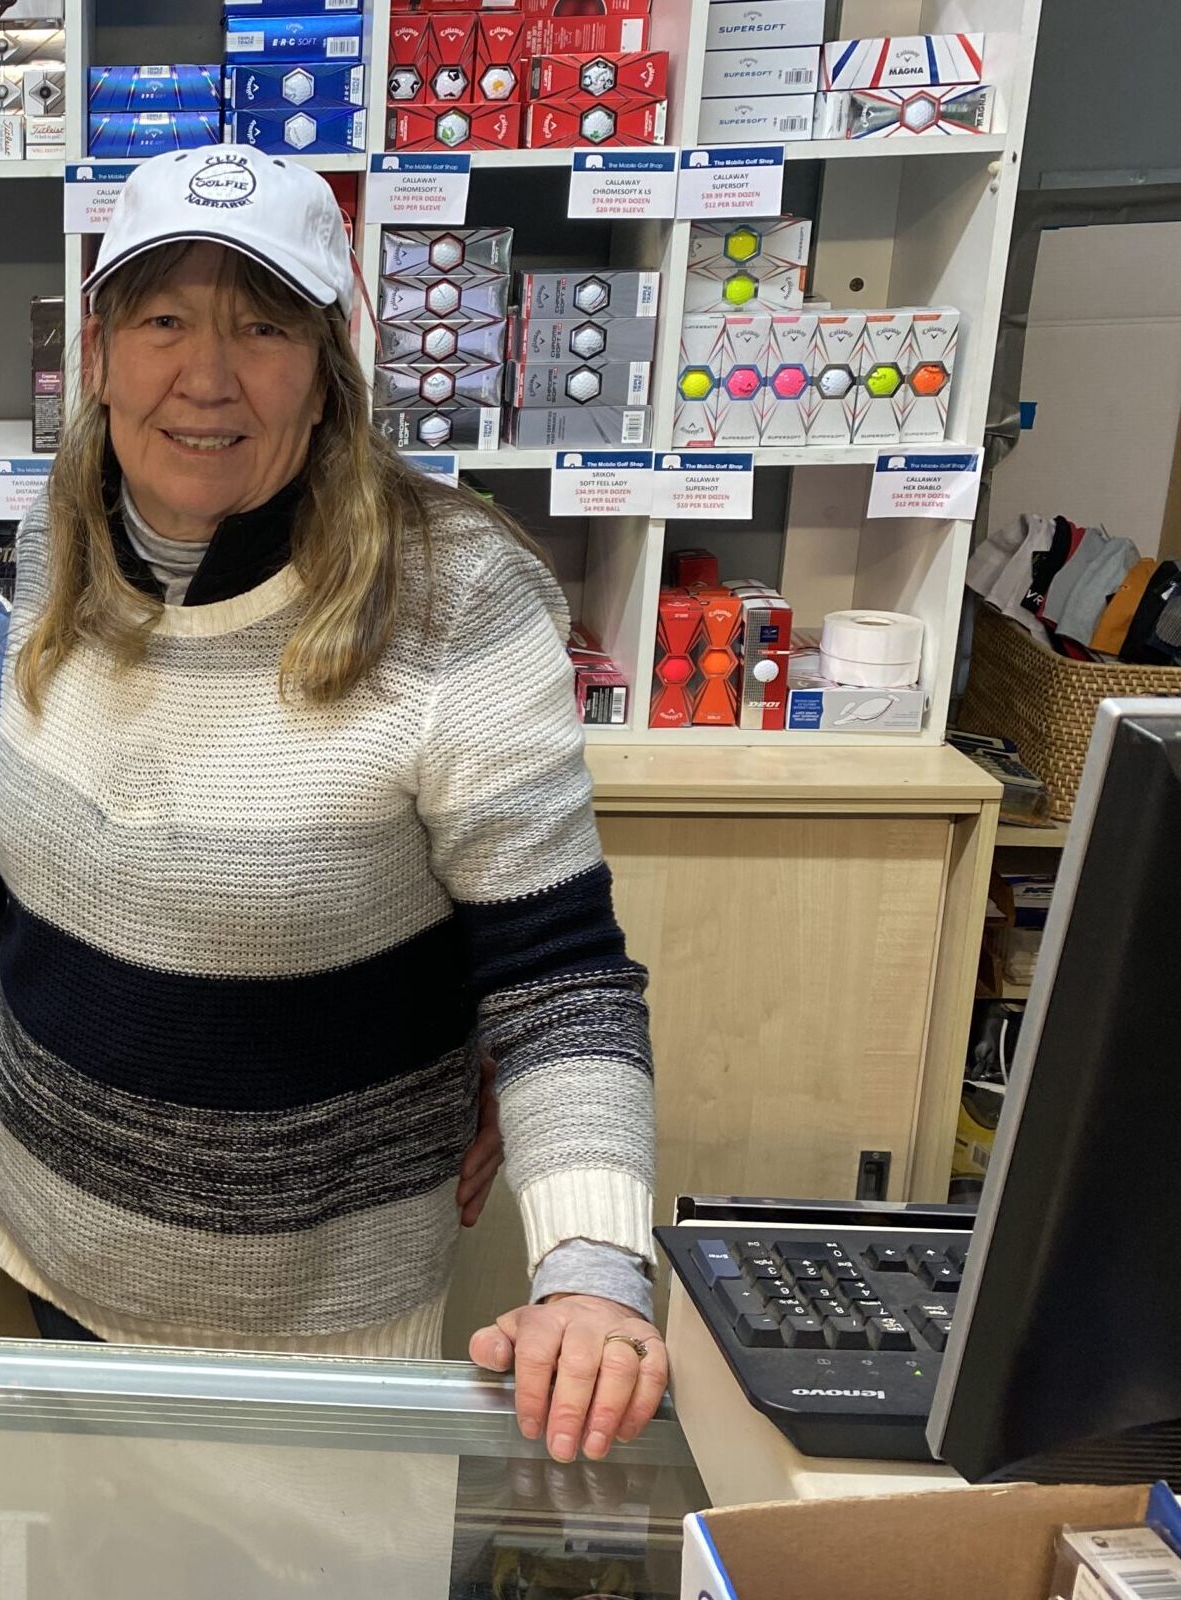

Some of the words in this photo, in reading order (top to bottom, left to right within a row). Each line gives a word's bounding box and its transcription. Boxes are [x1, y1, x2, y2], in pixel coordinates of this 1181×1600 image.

[394, 25, 419, 38] Callaway
[439, 25, 465, 37] Callaway
[489, 25, 514, 37] Callaway
[718, 23, 787, 34] SUPERSOFT
[297, 37, 318, 46] SOFT
[723, 70, 773, 78] SUPERSOFT
[888, 66, 925, 77] MAGNA
[976, 93, 988, 127] MAGNA
[718, 117, 768, 126] SUPERSOFT
[31, 126, 65, 136] Titleist
[205, 154, 248, 166] CLUB
[712, 182, 750, 190] SUPERSOFT
[735, 330, 761, 339] Callaway
[781, 329, 807, 338] Callaway
[828, 329, 854, 338] Callaway
[875, 328, 902, 337] Callaway
[921, 327, 948, 336] Callaway
[791, 1388, 886, 1400] lenovo
